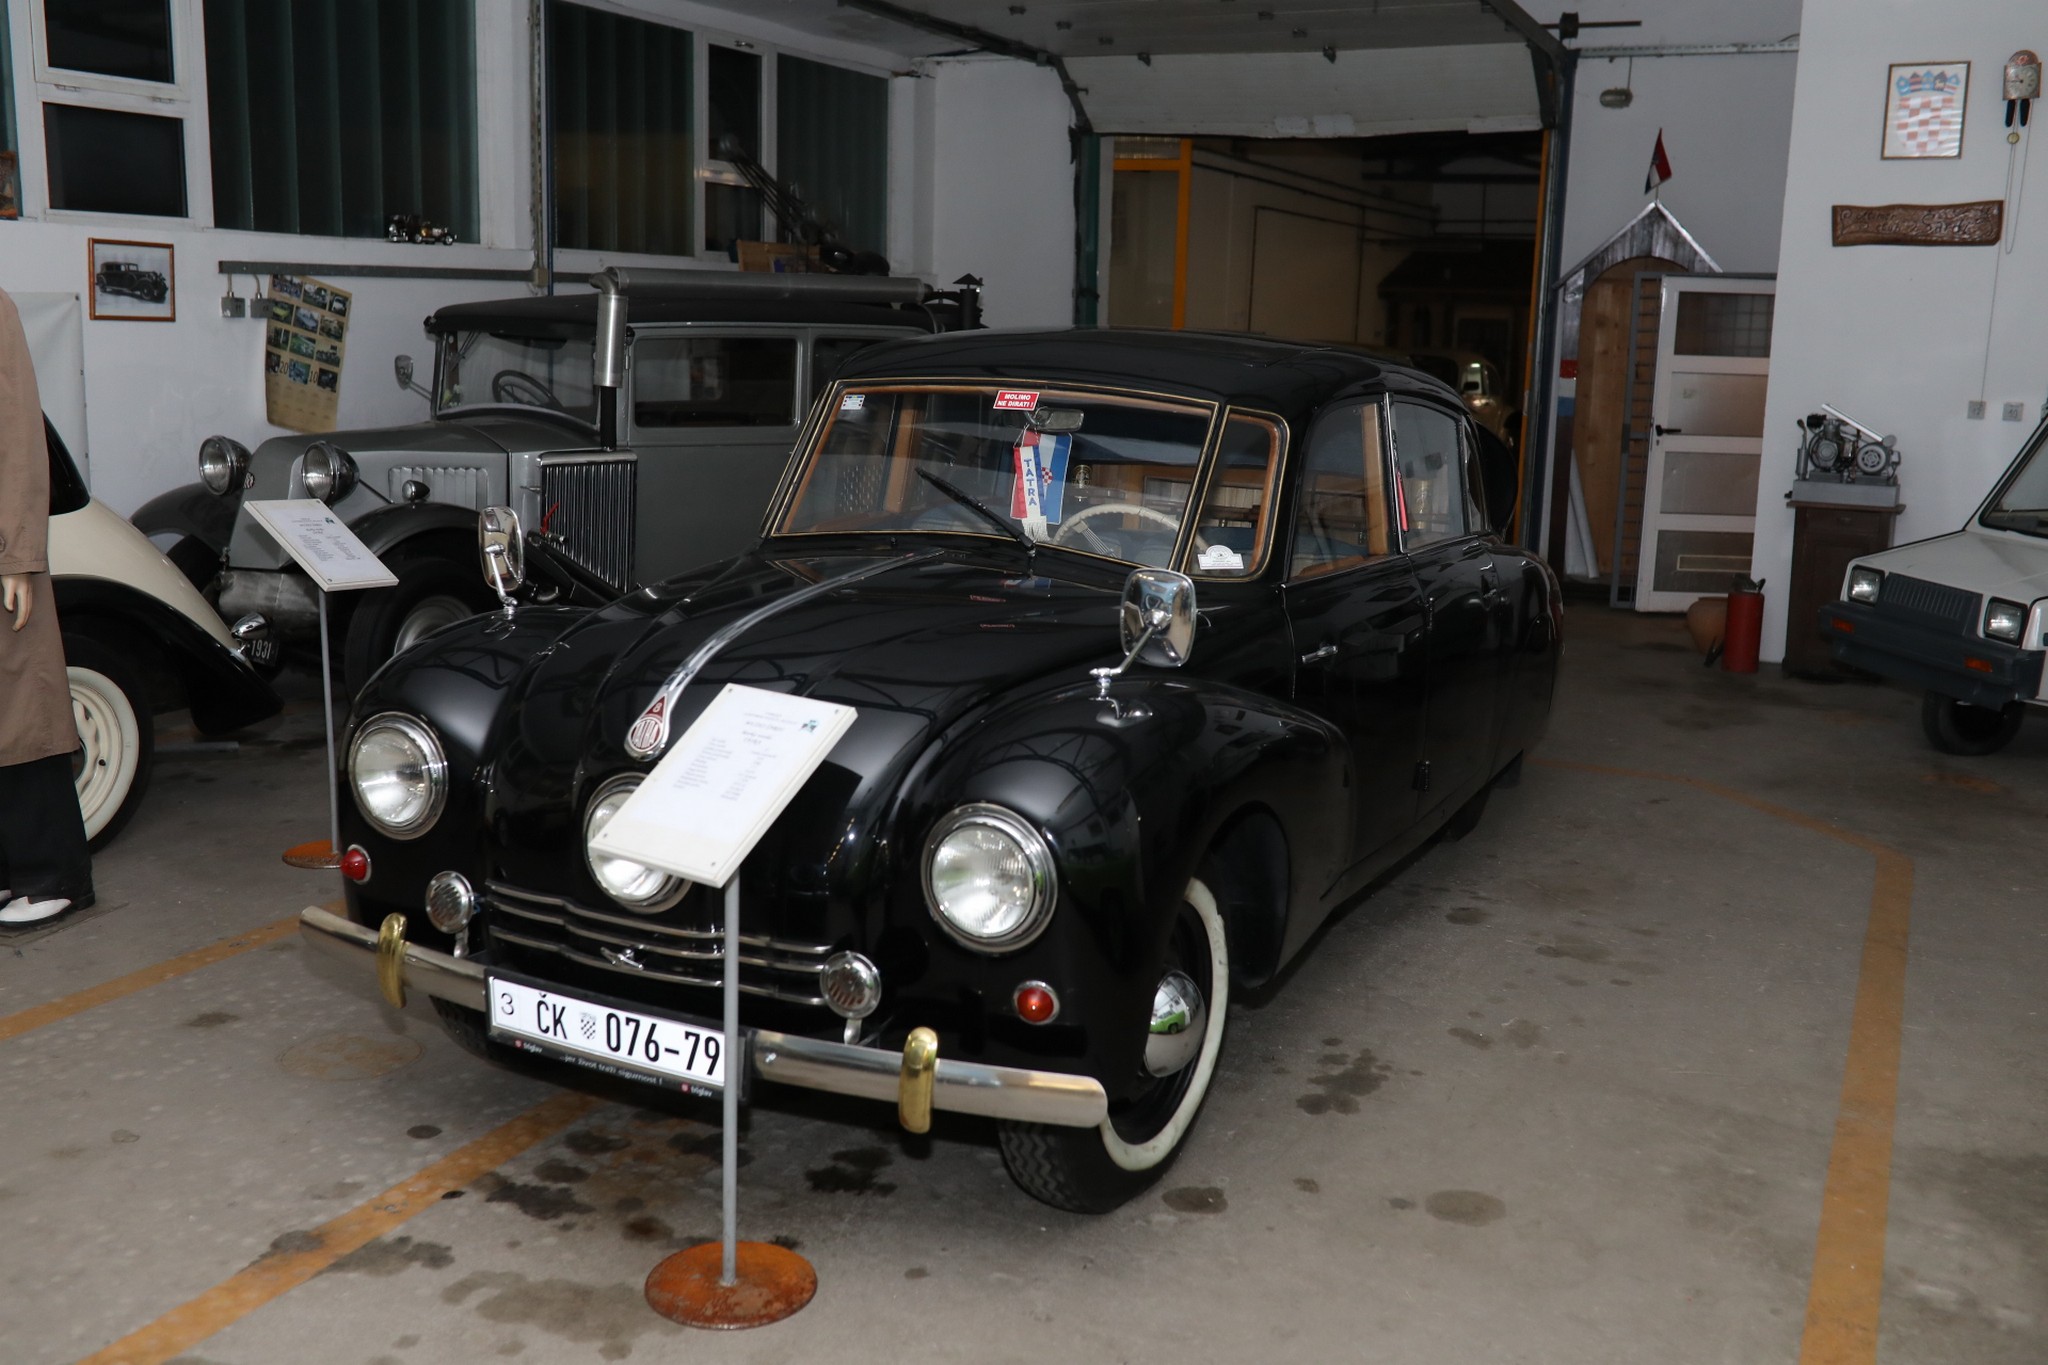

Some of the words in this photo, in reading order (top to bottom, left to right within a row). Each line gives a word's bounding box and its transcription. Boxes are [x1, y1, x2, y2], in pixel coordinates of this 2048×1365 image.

[1004, 393, 1031, 401] MOLIMO
[1023, 458, 1037, 507] TATRA
[251, 639, 272, 660] 1931
[652, 702, 663, 713] 8
[536, 991, 568, 1040] ČK
[605, 1011, 721, 1077] 076-79
